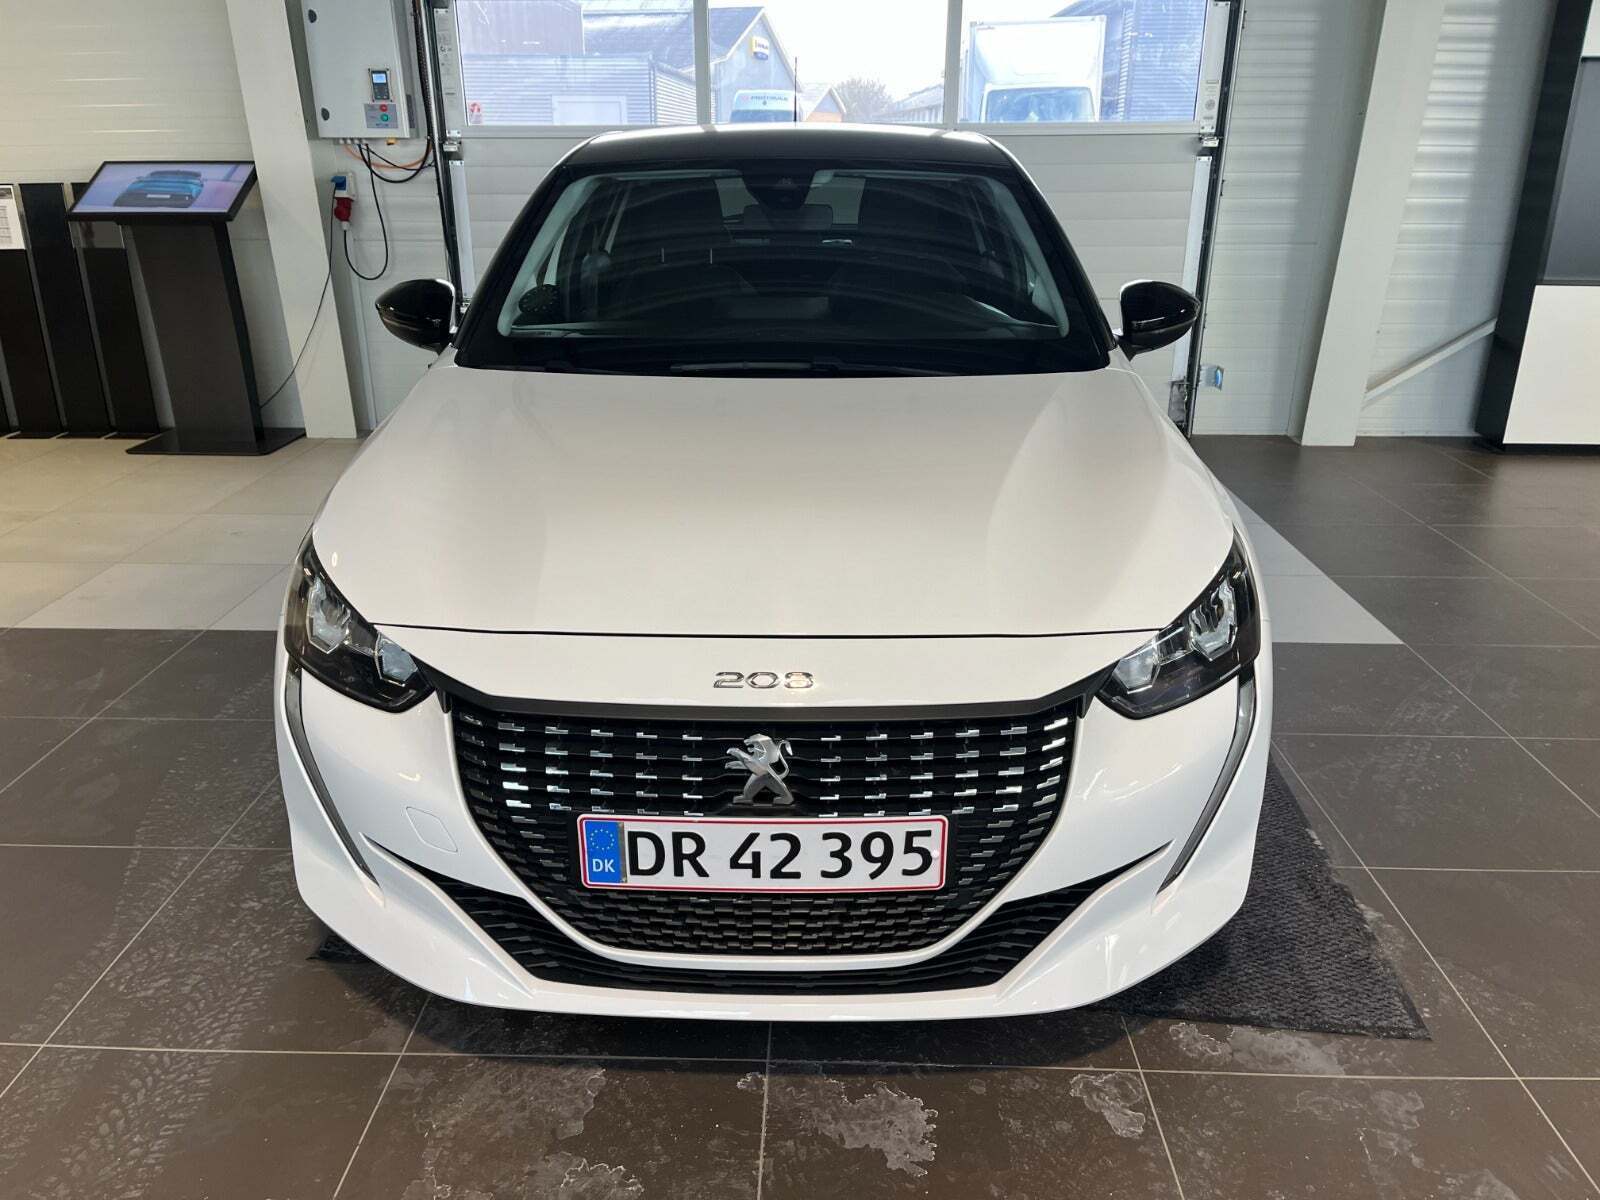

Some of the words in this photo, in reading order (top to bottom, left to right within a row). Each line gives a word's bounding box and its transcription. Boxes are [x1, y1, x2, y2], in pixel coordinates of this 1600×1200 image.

[713, 671, 814, 689] 208
[627, 830, 710, 878] DR
[729, 831, 802, 880] 42
[820, 829, 933, 880] 395
[592, 858, 616, 873] DK
